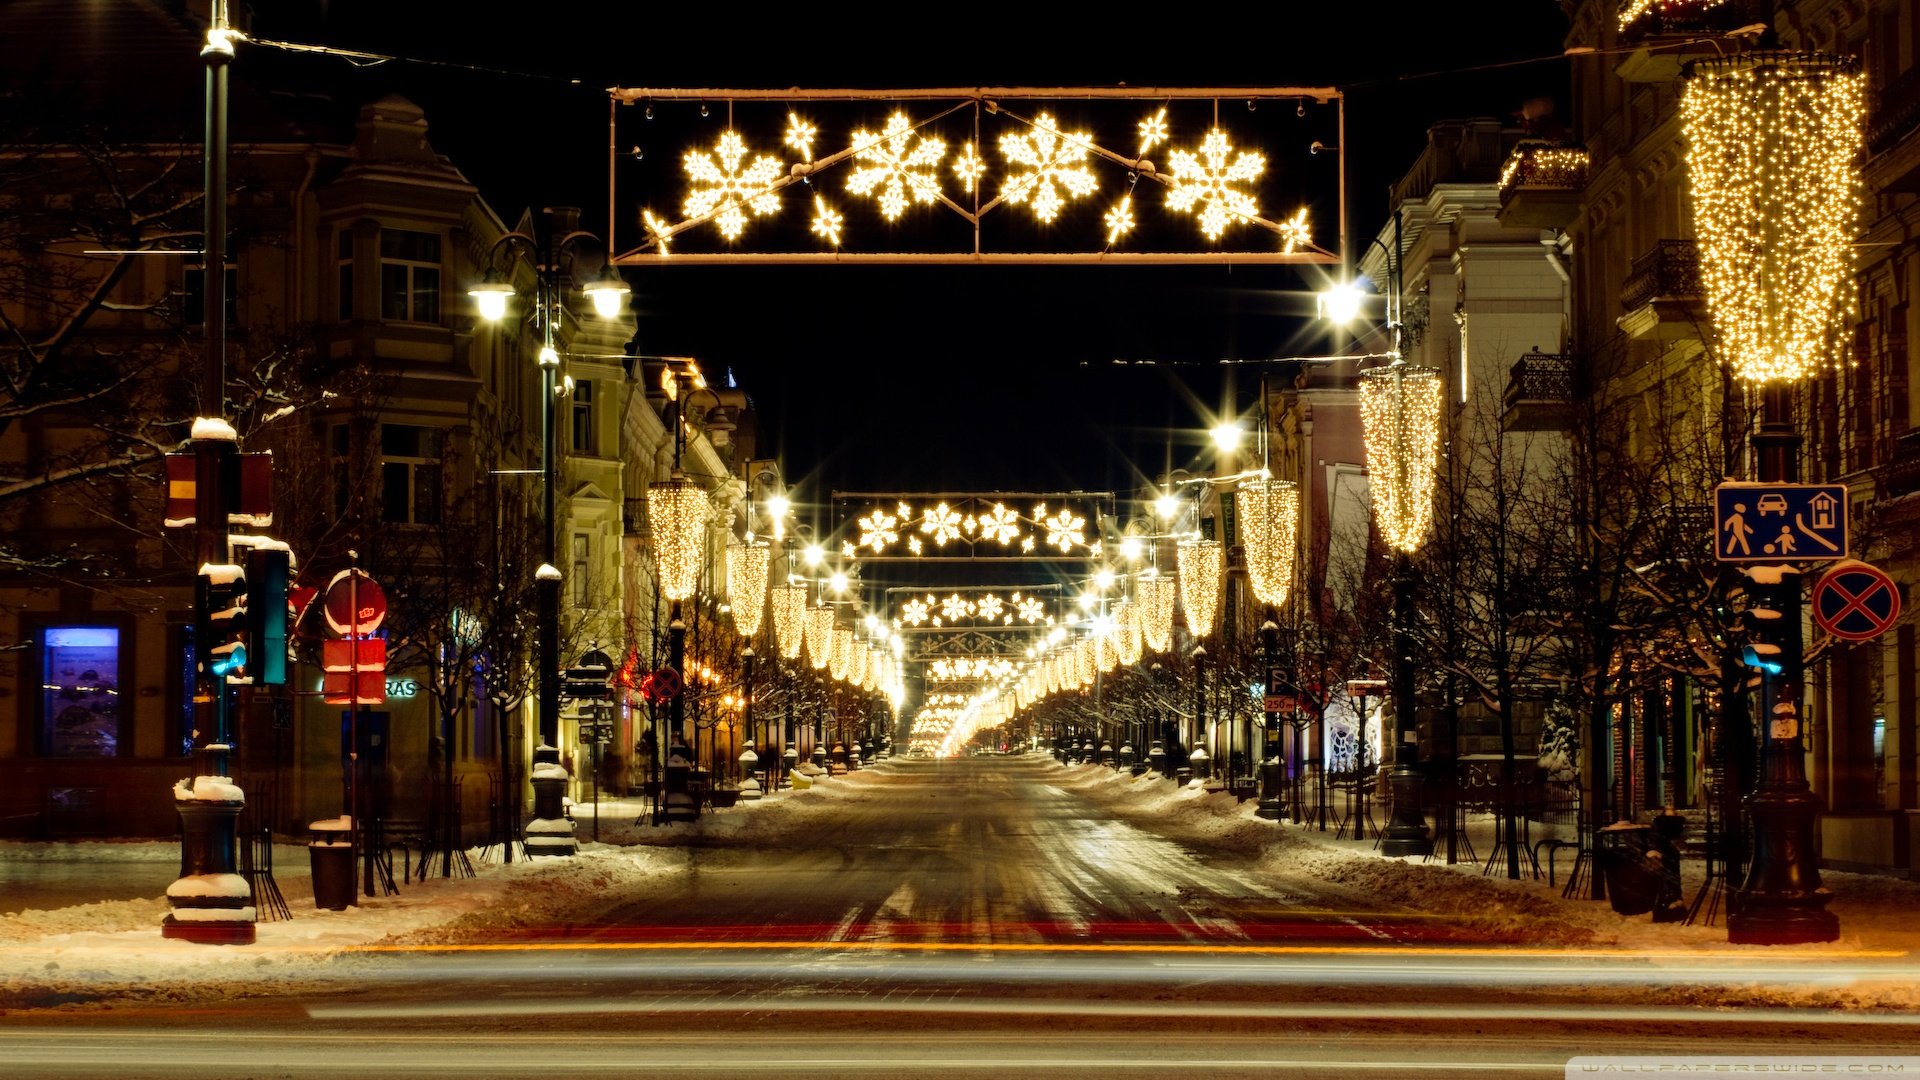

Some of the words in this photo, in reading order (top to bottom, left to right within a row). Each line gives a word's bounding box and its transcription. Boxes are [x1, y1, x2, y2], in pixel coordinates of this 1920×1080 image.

[386, 681, 416, 696] RAS
[1272, 669, 1288, 693] P
[1268, 701, 1285, 709] 250
